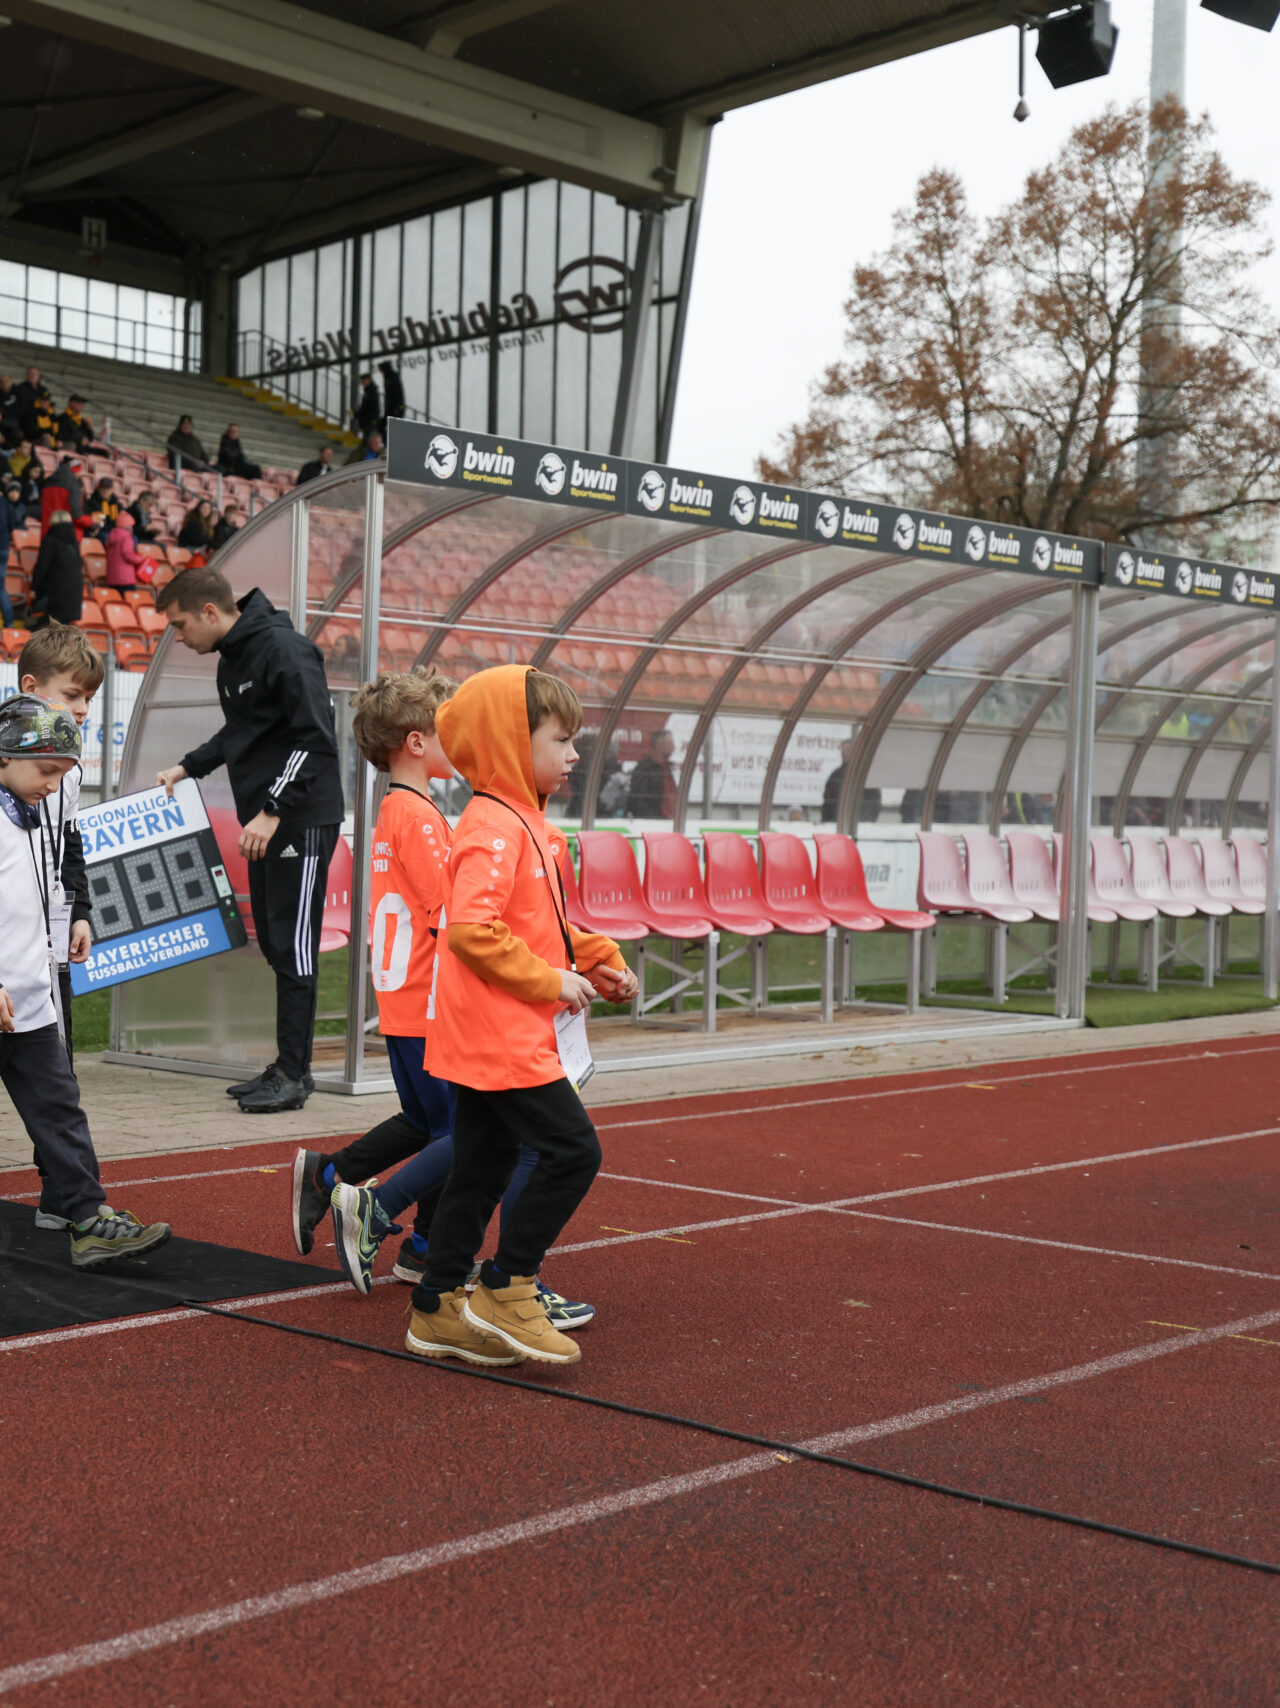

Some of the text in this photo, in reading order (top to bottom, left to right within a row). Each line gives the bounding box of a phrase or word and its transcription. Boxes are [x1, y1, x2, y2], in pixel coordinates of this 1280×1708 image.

[87, 220, 103, 249] H
[463, 442, 516, 475] bwin
[462, 470, 514, 487] Sportwetten
[570, 460, 618, 492] bwin
[570, 486, 617, 502] Sportwetten
[669, 477, 714, 508] bwin
[759, 492, 800, 522] bwin
[669, 503, 712, 517] Sportwetten
[842, 506, 880, 535] bwin
[918, 519, 953, 546] bwin
[988, 531, 1021, 557] bwin
[1053, 541, 1084, 567] bwin
[1136, 556, 1166, 581] bwin
[1194, 566, 1222, 590] bwin
[1250, 575, 1276, 598] bwin
[79, 794, 178, 831] EGIONALLIGA
[81, 805, 186, 856] BAYERN
[84, 922, 207, 971] BAYERISCHER
[87, 936, 210, 983] FUSSBALL-VERBAND
